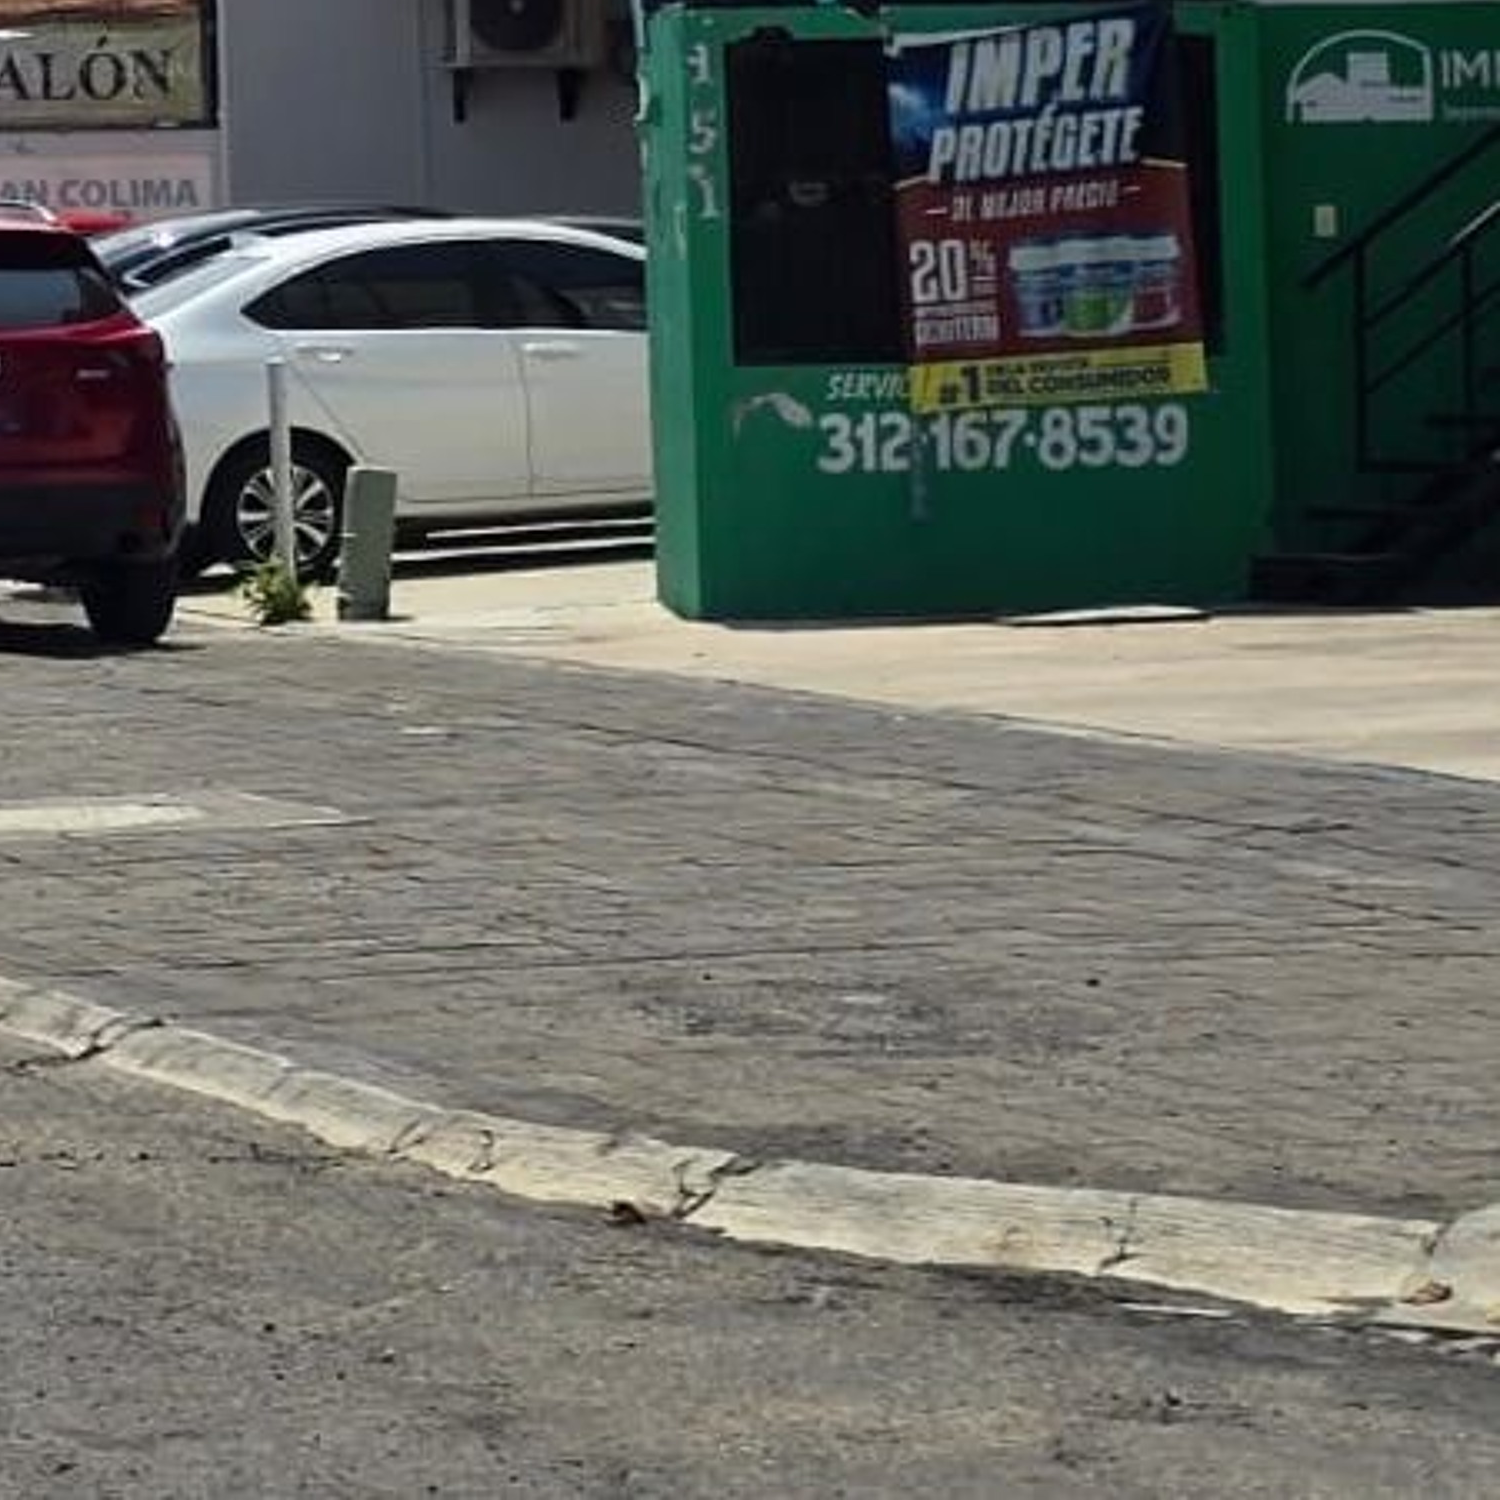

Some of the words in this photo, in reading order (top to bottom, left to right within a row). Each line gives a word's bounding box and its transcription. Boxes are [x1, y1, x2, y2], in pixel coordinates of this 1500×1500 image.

[945, 18, 1135, 114] IMPER
[927, 100, 1144, 184] PROTÉGETE
[54, 178, 198, 207] COLIMA
